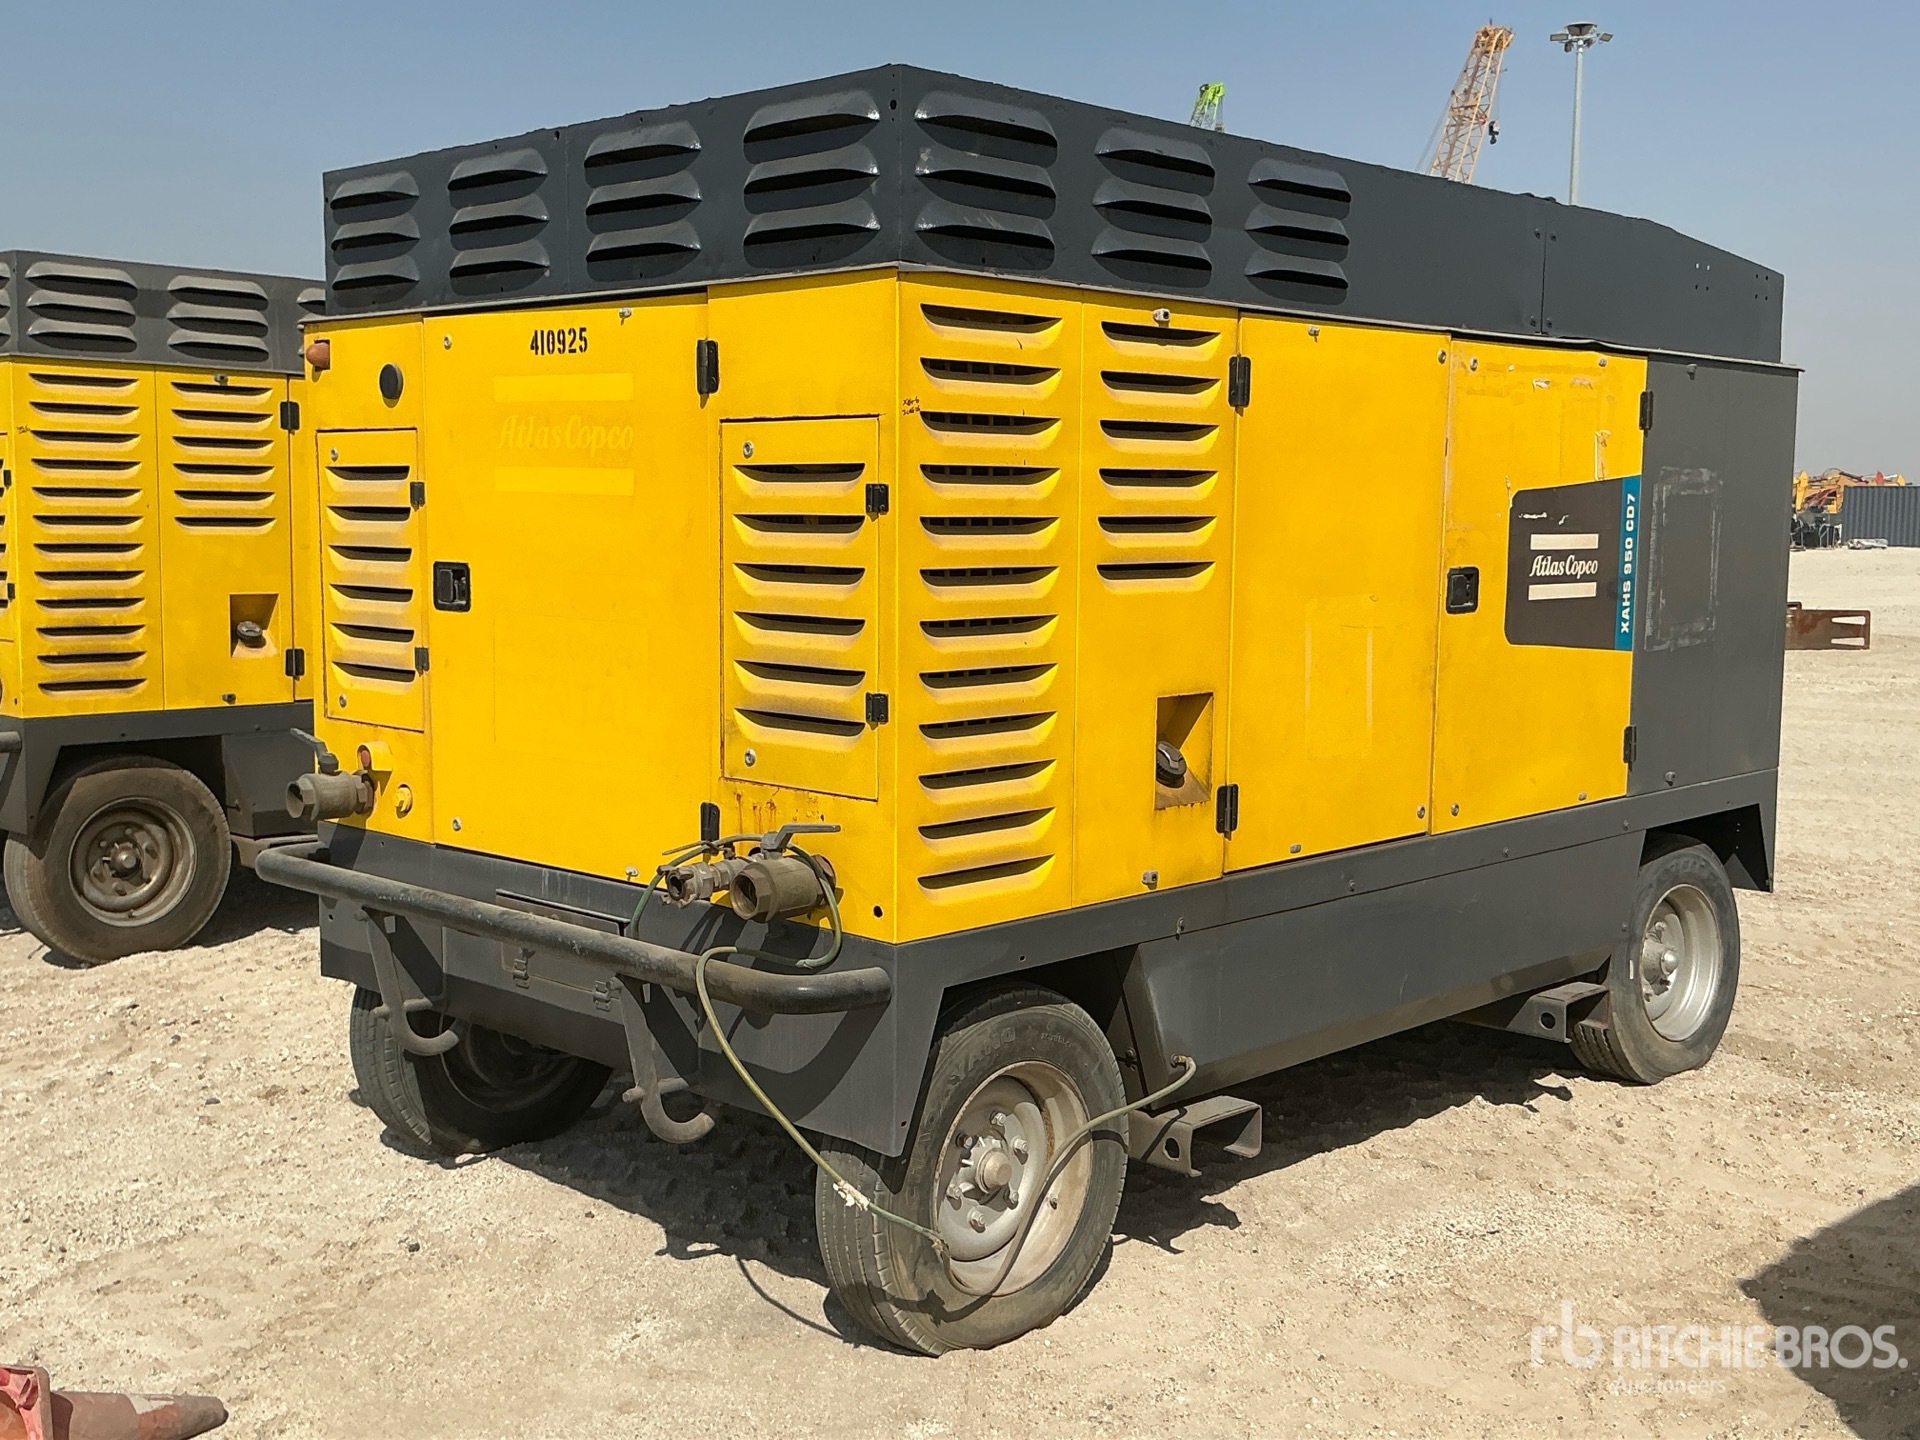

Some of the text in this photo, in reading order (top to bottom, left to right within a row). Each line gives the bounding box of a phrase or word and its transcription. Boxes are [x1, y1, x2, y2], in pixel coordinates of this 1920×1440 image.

[530, 327, 588, 355] 410925
[1529, 554, 1598, 579] Atlas Copco
[1621, 494, 1635, 633] XAHS 950 CD7
